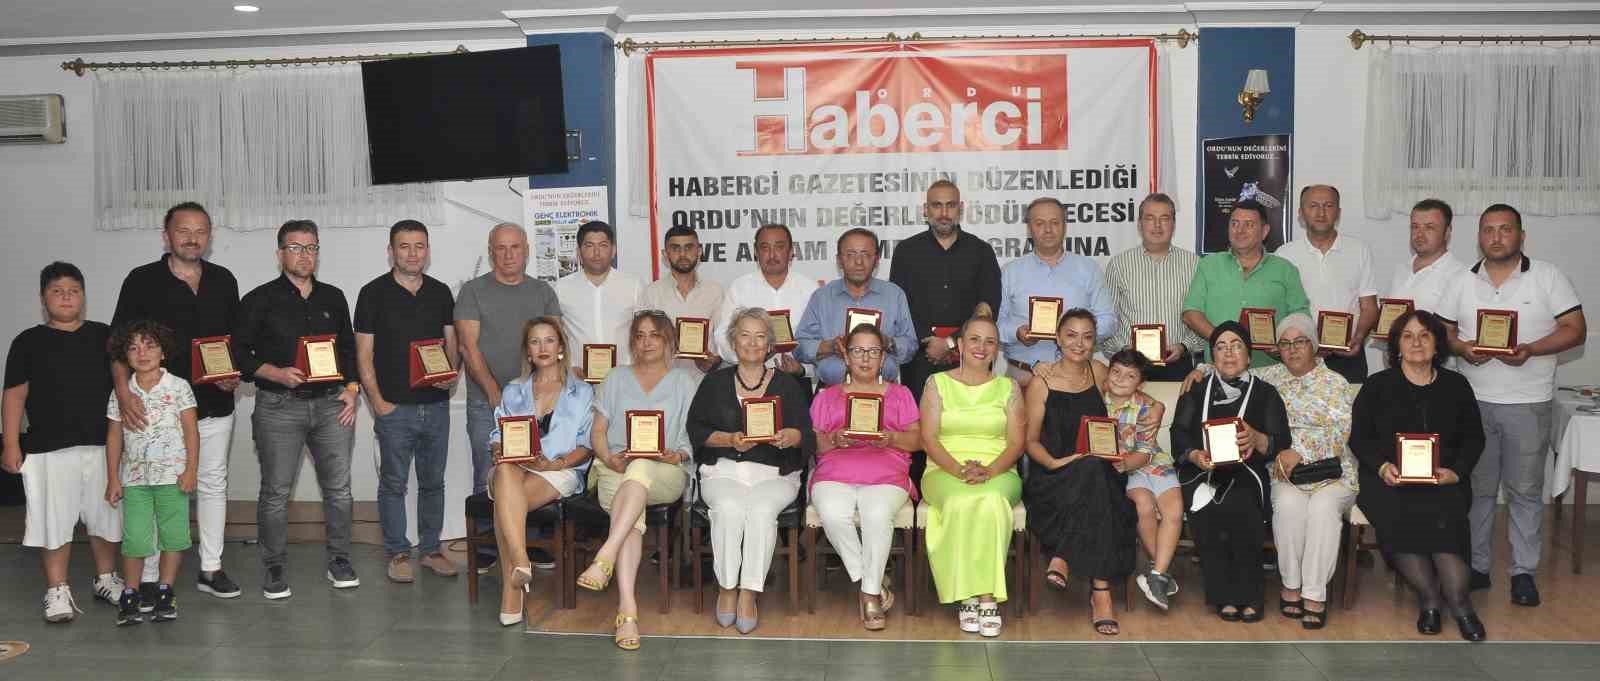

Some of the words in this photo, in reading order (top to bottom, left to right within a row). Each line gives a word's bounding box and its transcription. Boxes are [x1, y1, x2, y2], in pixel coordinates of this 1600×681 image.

[736, 67, 1042, 152] Haberci
[668, 171, 779, 197] HABERCİ
[968, 164, 1137, 191] DÜZENLEDİĞİ
[672, 207, 807, 230] ORDU'NUN
[1063, 199, 1136, 223] ECESİ
[699, 242, 727, 262] VE
